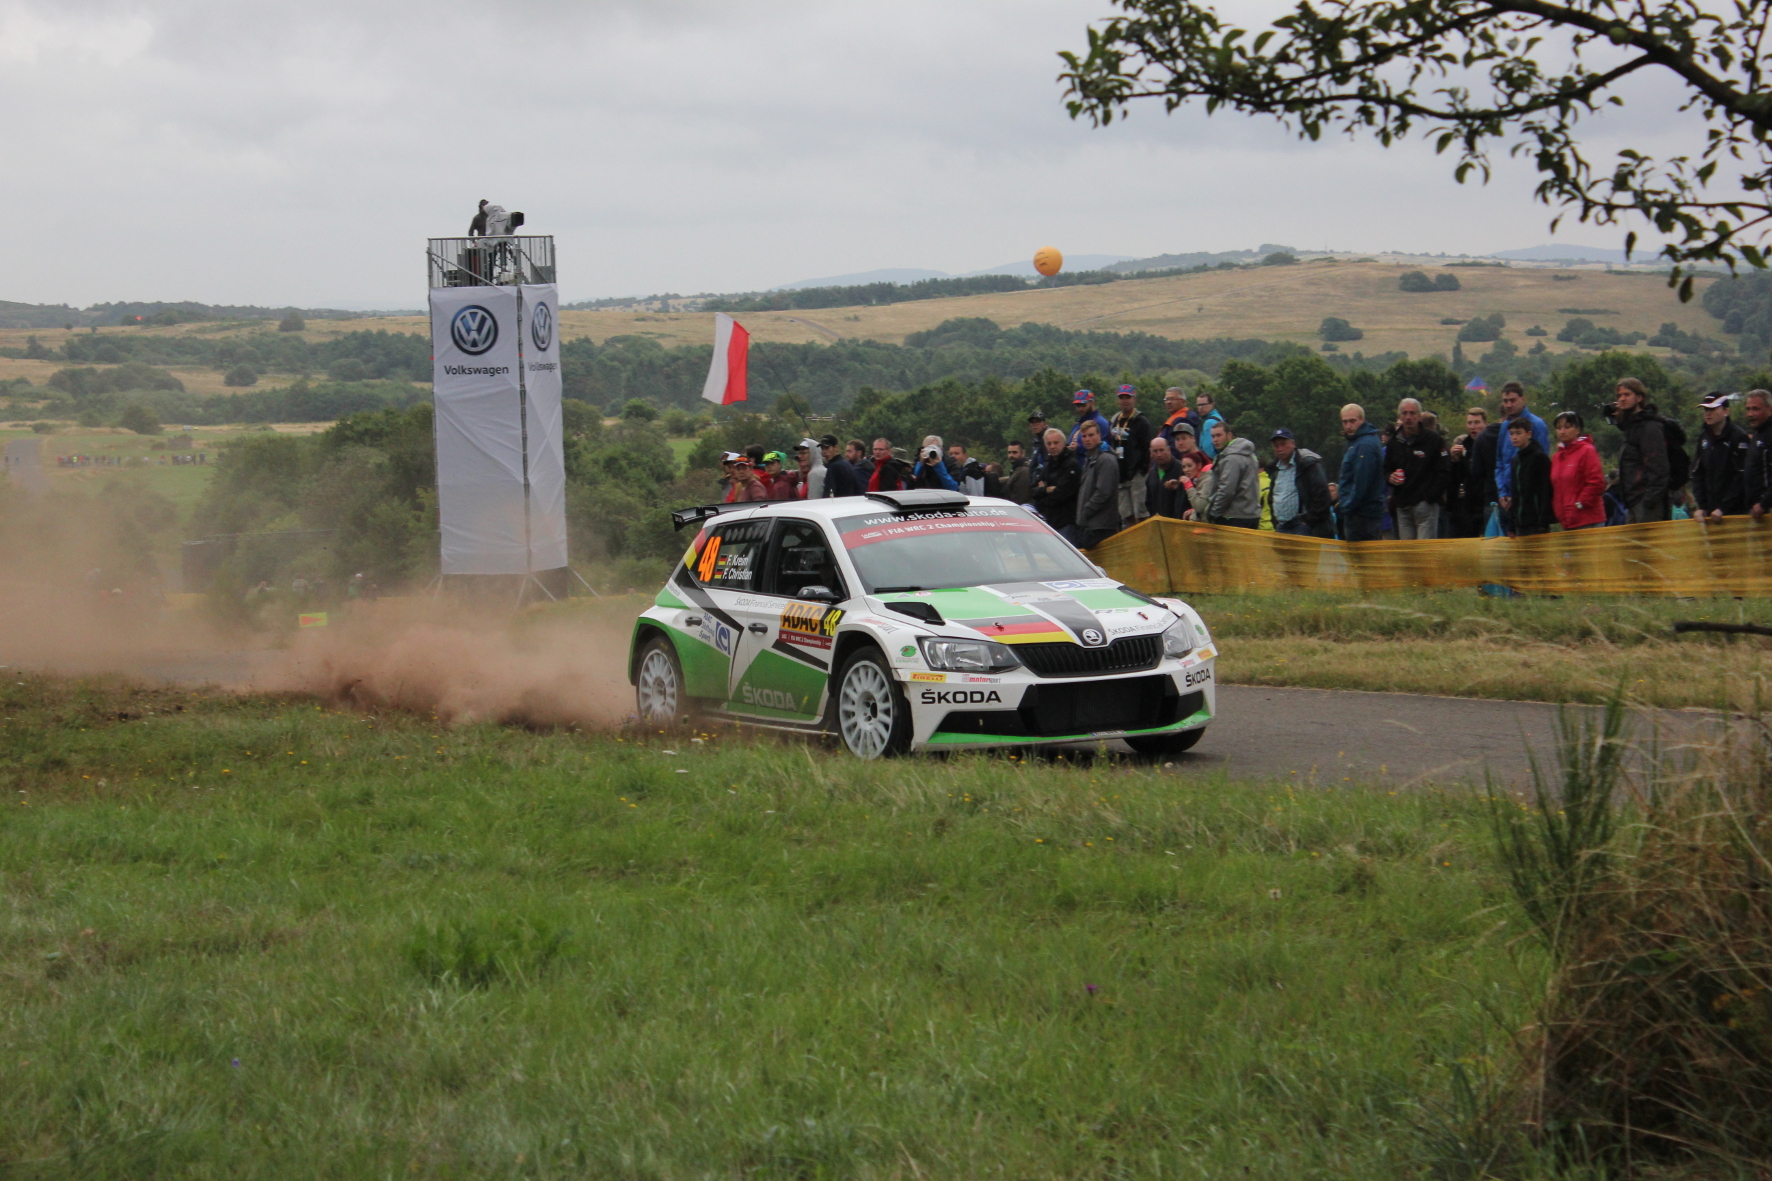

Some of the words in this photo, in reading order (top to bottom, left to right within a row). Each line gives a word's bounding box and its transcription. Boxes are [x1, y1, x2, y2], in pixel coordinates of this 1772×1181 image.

[444, 365, 509, 377] Volkswagen
[527, 362, 557, 372] Volkswagen
[864, 509, 1008, 525] www.skoda-auto.de
[935, 521, 995, 529] Championship
[698, 536, 721, 582] 48
[728, 568, 752, 580] Christian
[782, 604, 822, 632] ADAC
[824, 609, 842, 636] 48
[912, 673, 943, 681] PIRELLI
[1186, 668, 1211, 687] ŠKODA
[742, 681, 798, 711] ŠKODA
[921, 689, 1002, 704] ŠKODA
